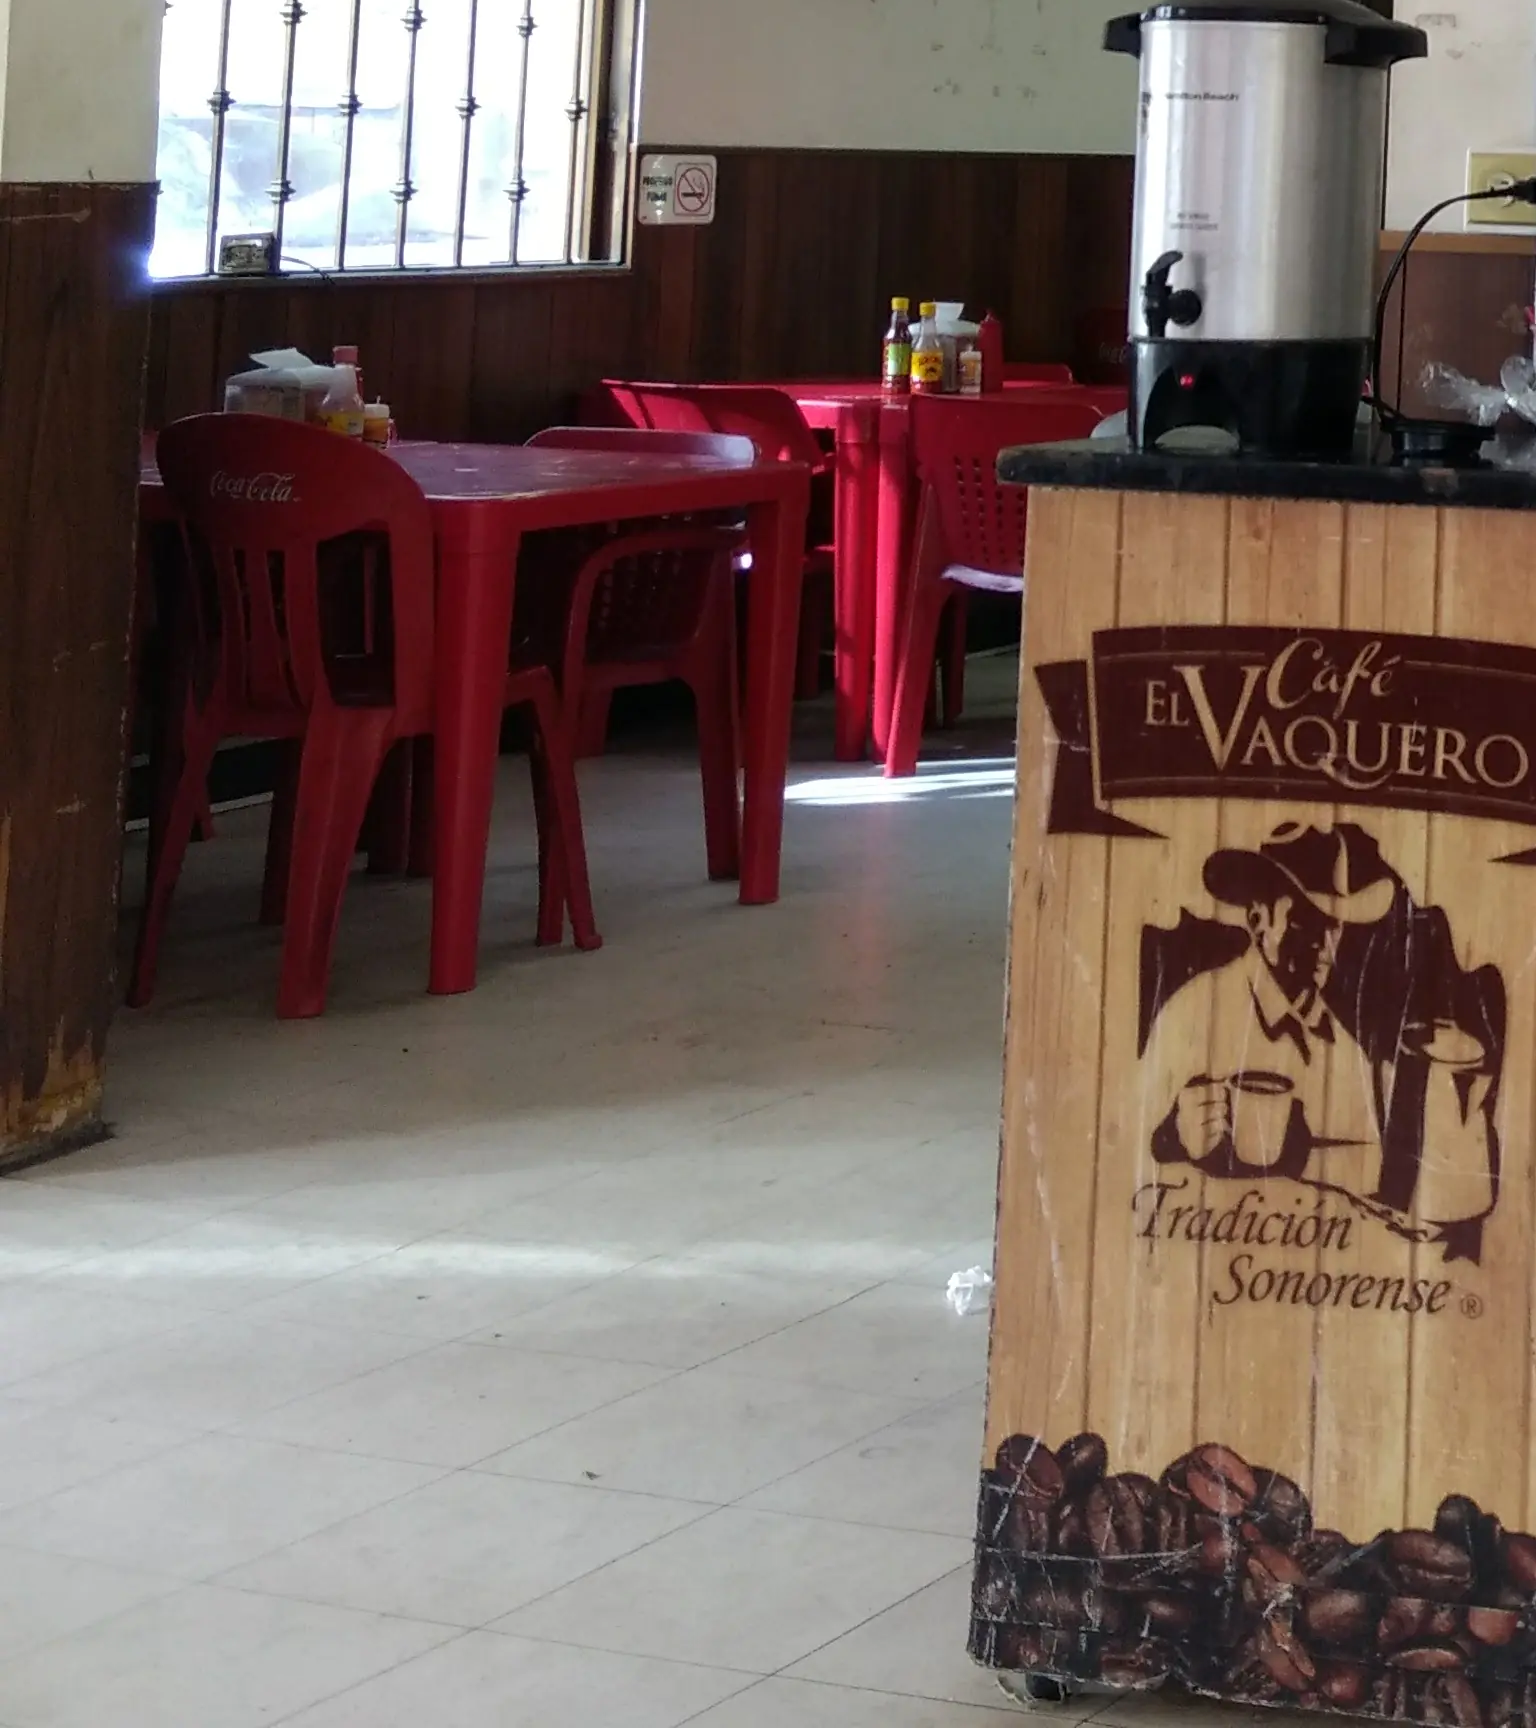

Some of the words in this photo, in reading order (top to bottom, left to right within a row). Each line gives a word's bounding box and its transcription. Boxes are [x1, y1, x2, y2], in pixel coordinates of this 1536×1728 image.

[1265, 637, 1401, 720] Café
[1172, 664, 1530, 790] VAQUERO
[1132, 1177, 1353, 1252] Tradición
[1212, 1253, 1451, 1314] Sonorense
